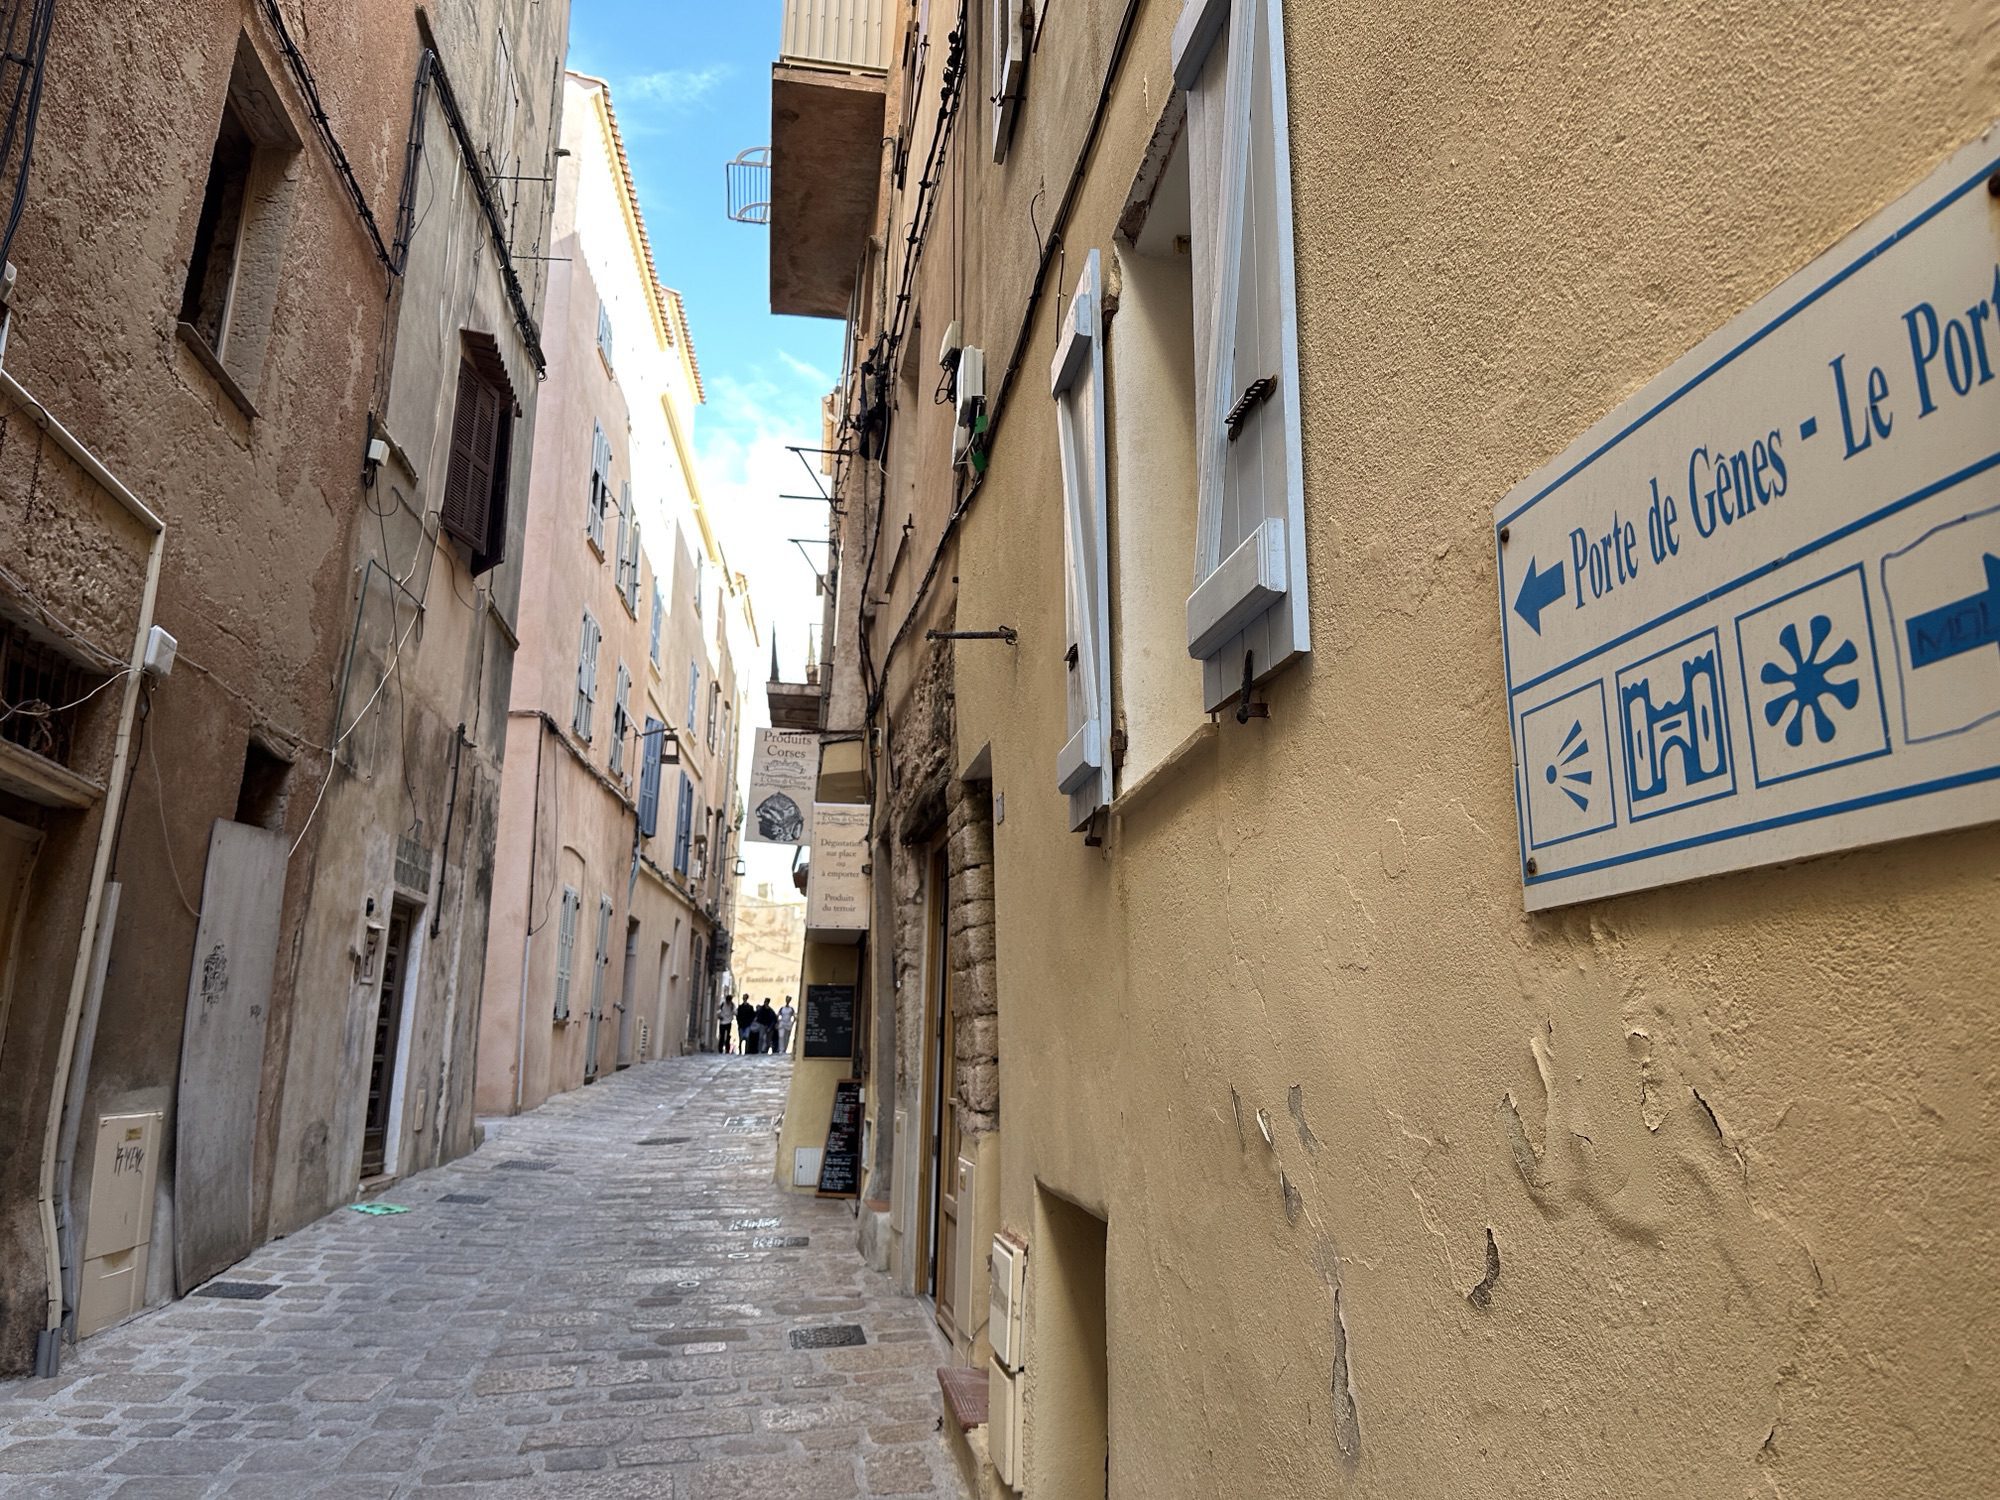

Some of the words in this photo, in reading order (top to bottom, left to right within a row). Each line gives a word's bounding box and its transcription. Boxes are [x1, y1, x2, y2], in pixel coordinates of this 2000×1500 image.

[1569, 510, 1640, 609] Porte
[1648, 477, 1679, 566] de
[1689, 425, 1788, 538] Gênes
[1829, 353, 1893, 461] Le
[763, 730, 812, 745] Produits
[766, 744, 807, 758] Corses
[820, 838, 863, 848] Dégustation
[838, 849, 857, 859] place
[827, 871, 860, 880] emporter
[823, 893, 855, 902] Produits
[822, 903, 832, 912] du
[833, 904, 857, 912] terroir
